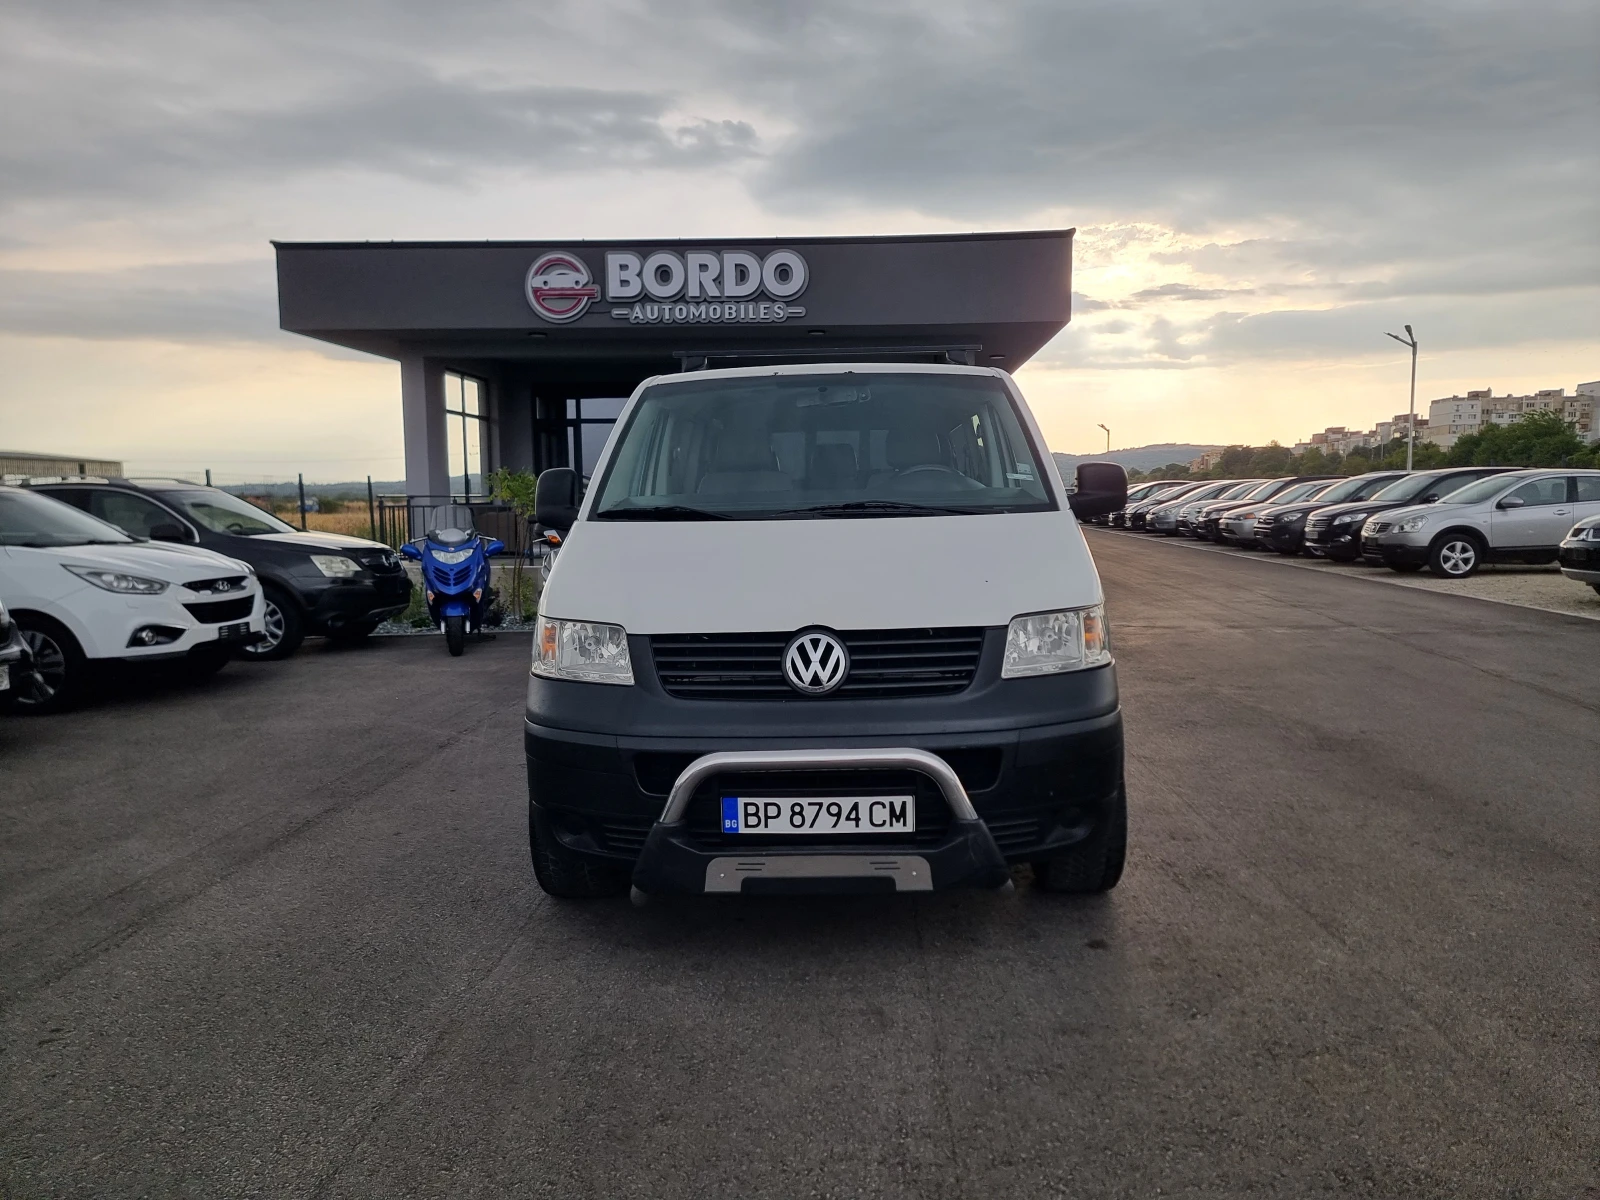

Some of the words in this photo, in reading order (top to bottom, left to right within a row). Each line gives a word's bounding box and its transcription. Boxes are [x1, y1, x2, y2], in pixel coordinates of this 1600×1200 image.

[606, 251, 805, 297] BORDO
[631, 303, 785, 320] AUTOMOBILES
[725, 819, 738, 829] BG
[743, 801, 782, 829] BP
[789, 801, 862, 829] 8794
[868, 800, 908, 828] CM
